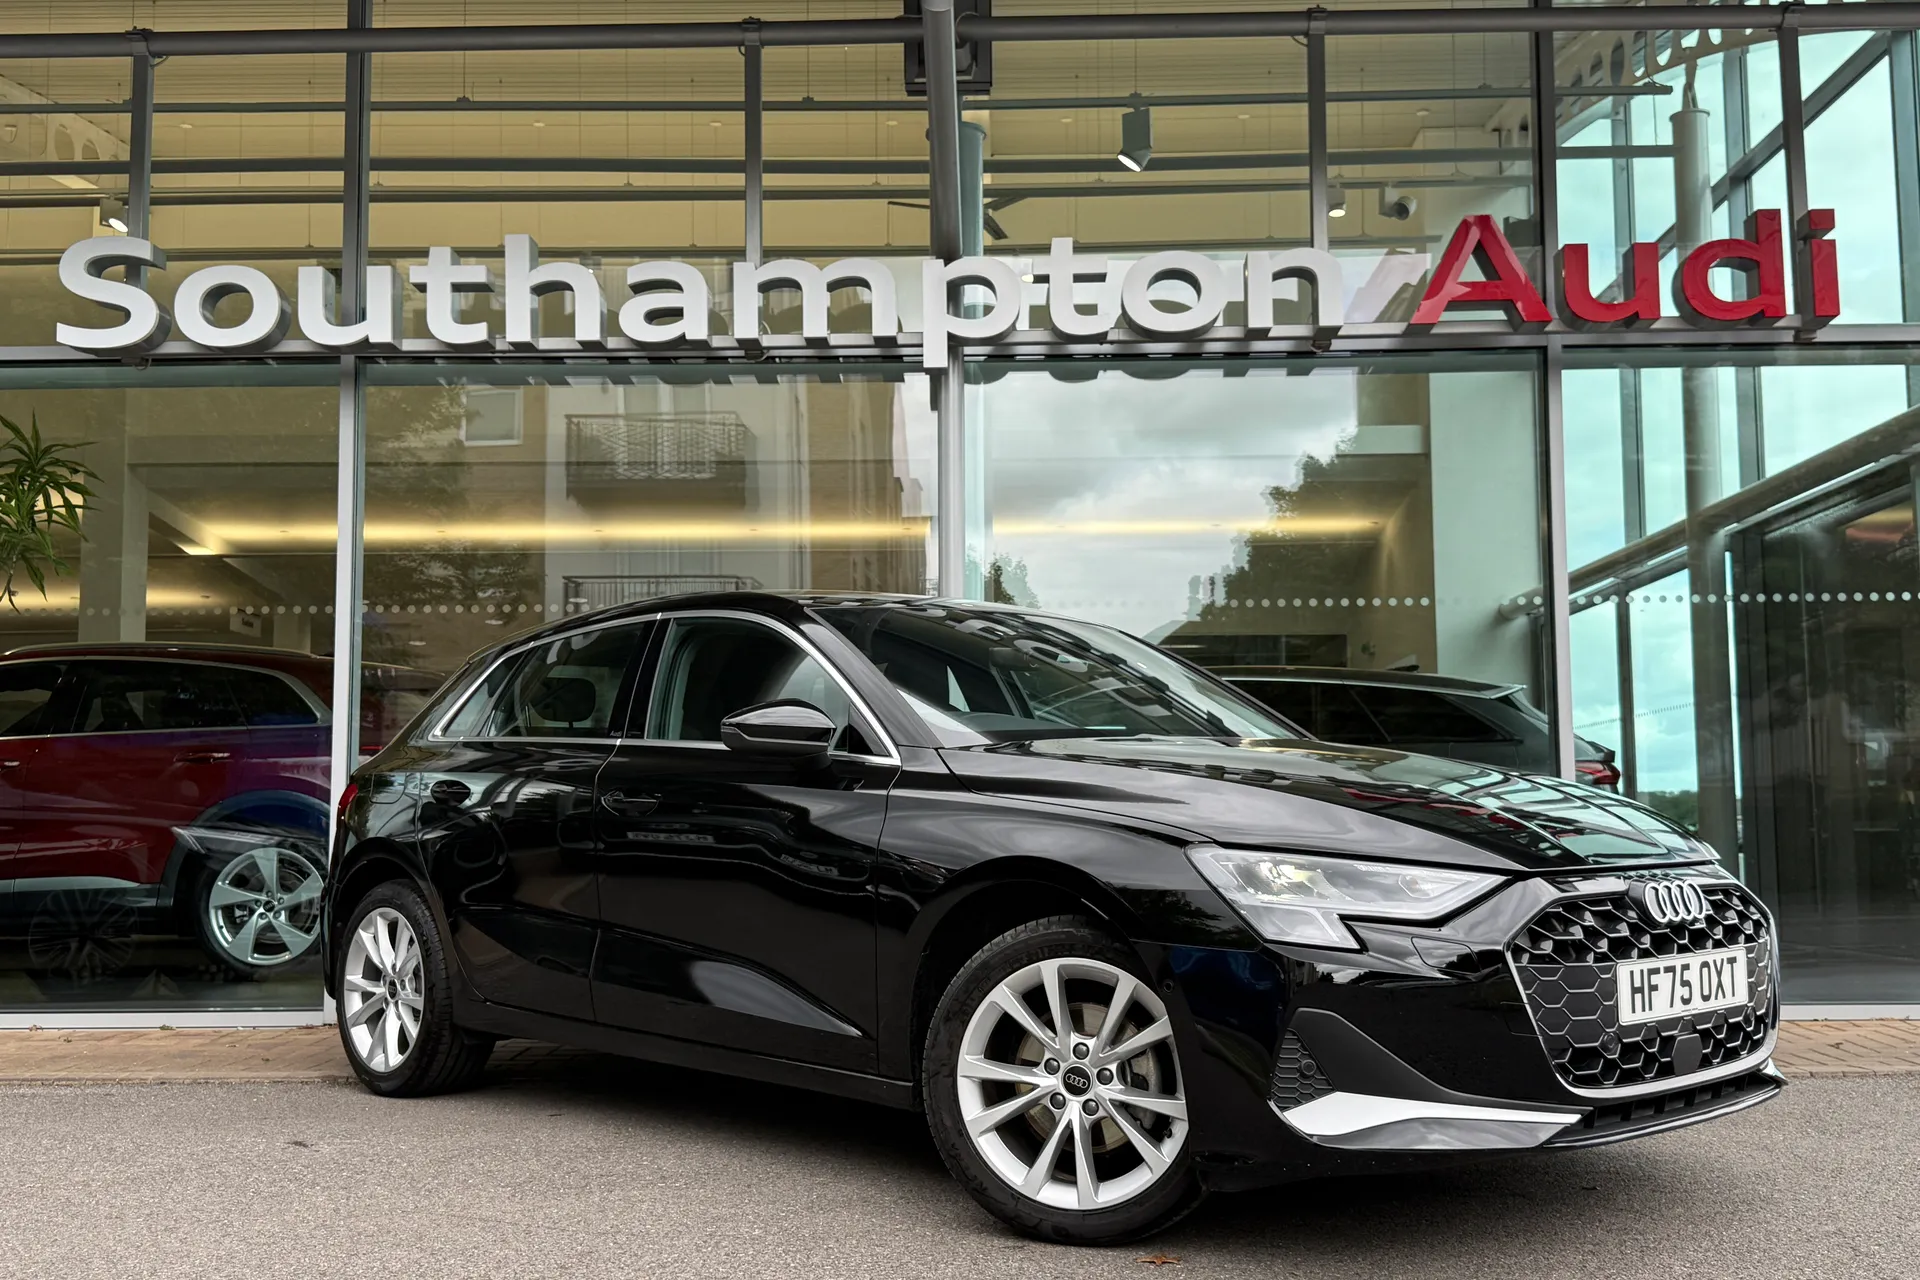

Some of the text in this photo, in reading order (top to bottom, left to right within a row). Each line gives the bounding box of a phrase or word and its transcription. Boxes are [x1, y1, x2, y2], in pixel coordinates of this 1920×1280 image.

[56, 208, 1841, 369] Southampton Audi
[1629, 956, 1737, 1014] HF75 OXT
